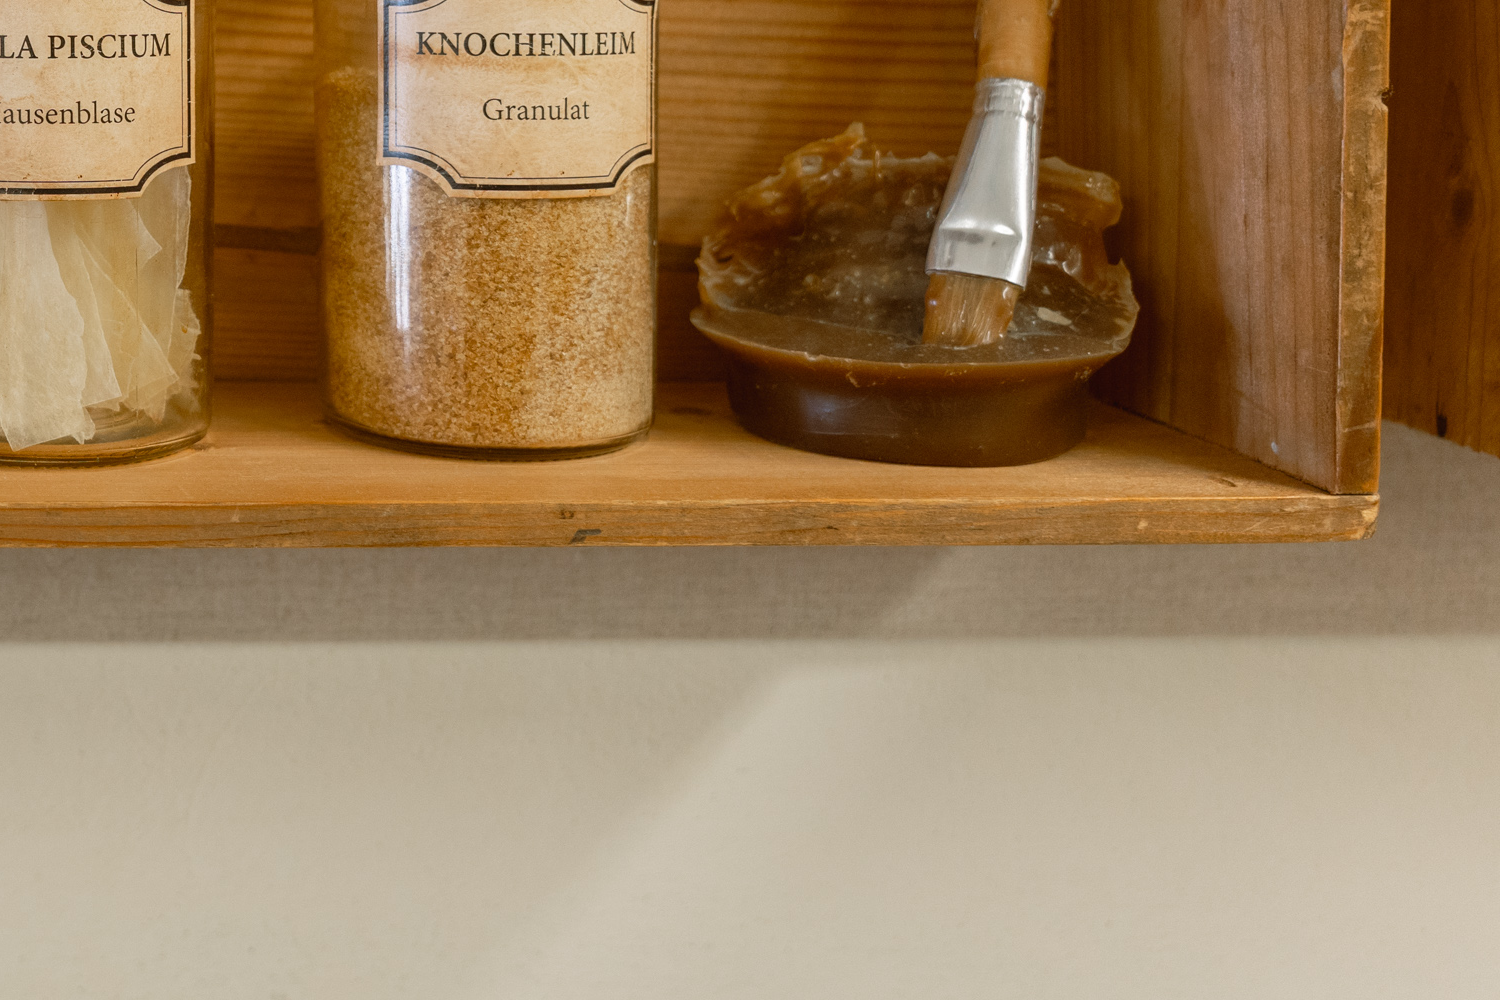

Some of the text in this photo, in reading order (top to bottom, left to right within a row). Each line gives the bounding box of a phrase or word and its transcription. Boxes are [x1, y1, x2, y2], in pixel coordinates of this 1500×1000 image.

[47, 32, 173, 60] PISCIUM
[415, 30, 637, 57] KNOCHENLEIM
[481, 97, 591, 122] Granulat
